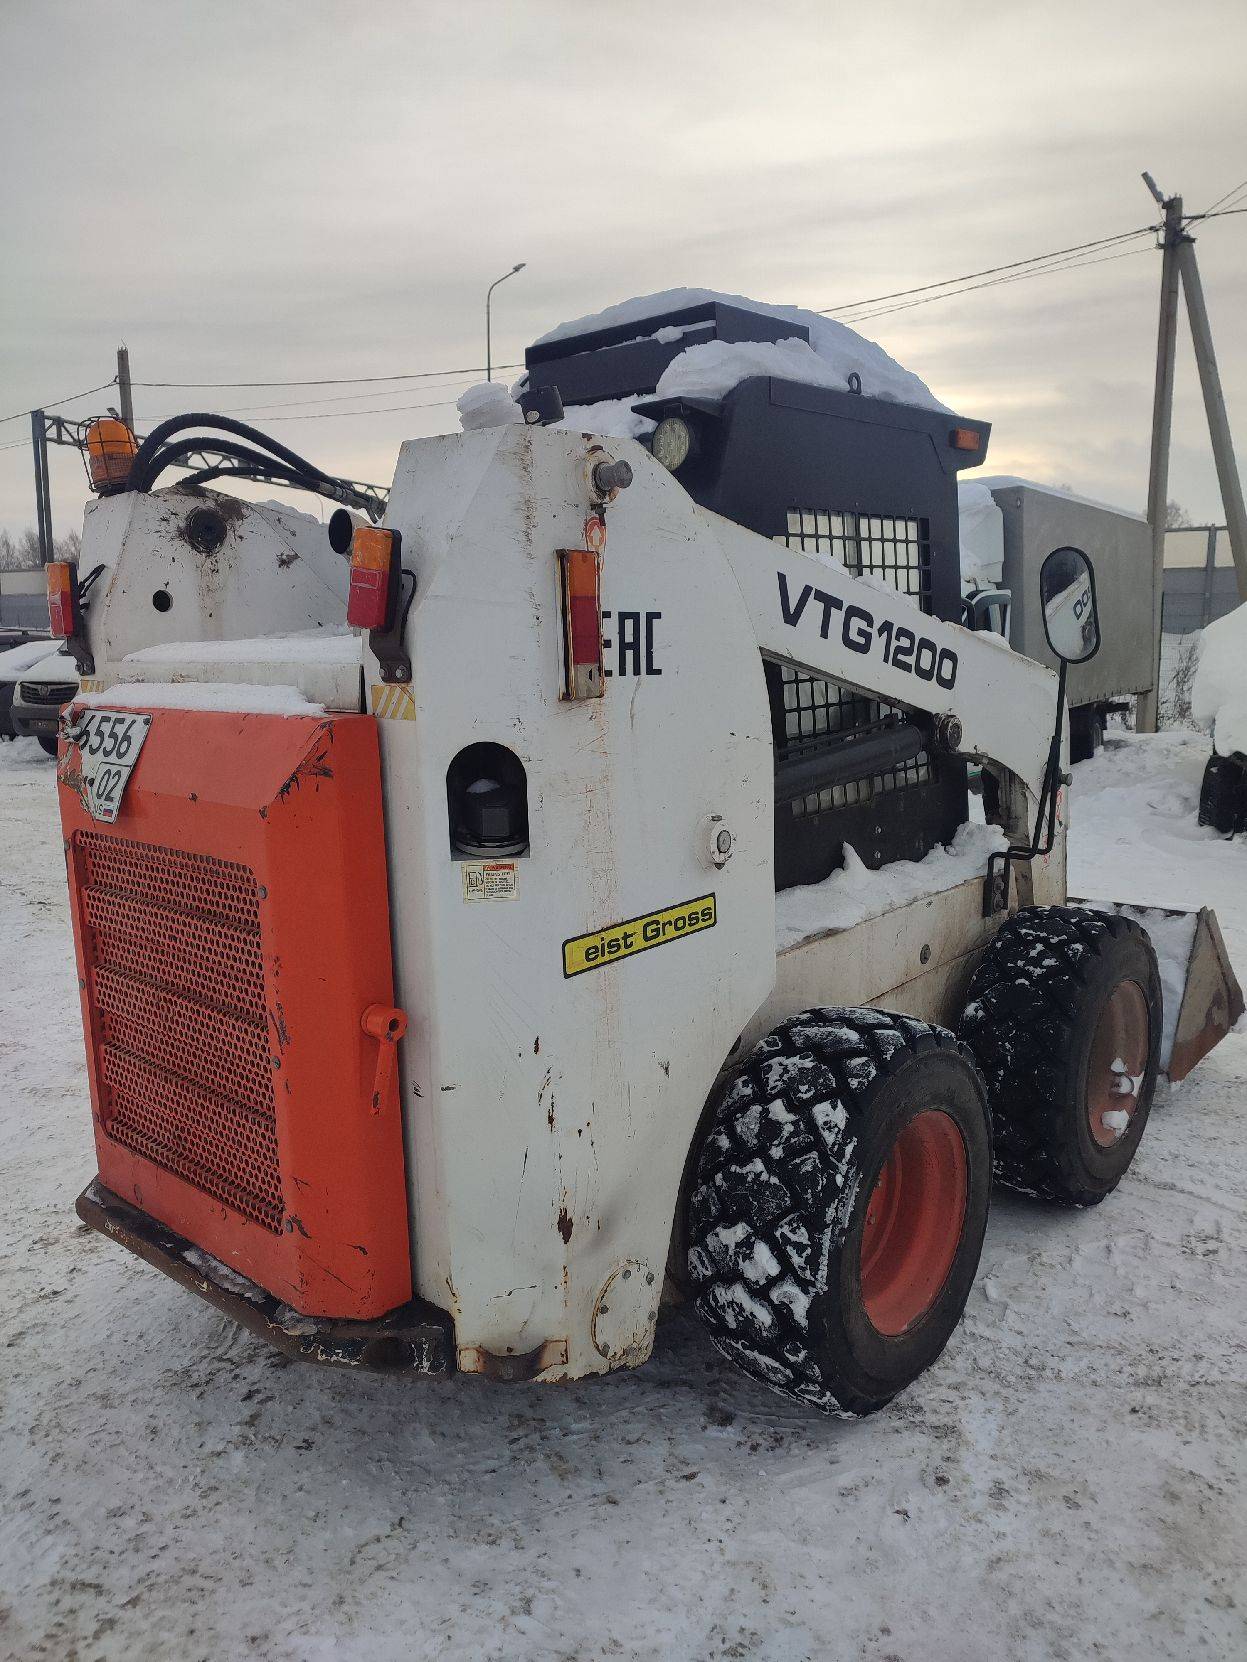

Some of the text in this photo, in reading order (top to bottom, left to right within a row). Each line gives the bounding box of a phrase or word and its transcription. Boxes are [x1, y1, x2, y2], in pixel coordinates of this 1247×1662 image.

[601, 611, 662, 677] EAC
[777, 571, 958, 690] VTG1200
[96, 769, 121, 802] 02
[642, 906, 713, 942] Gross
